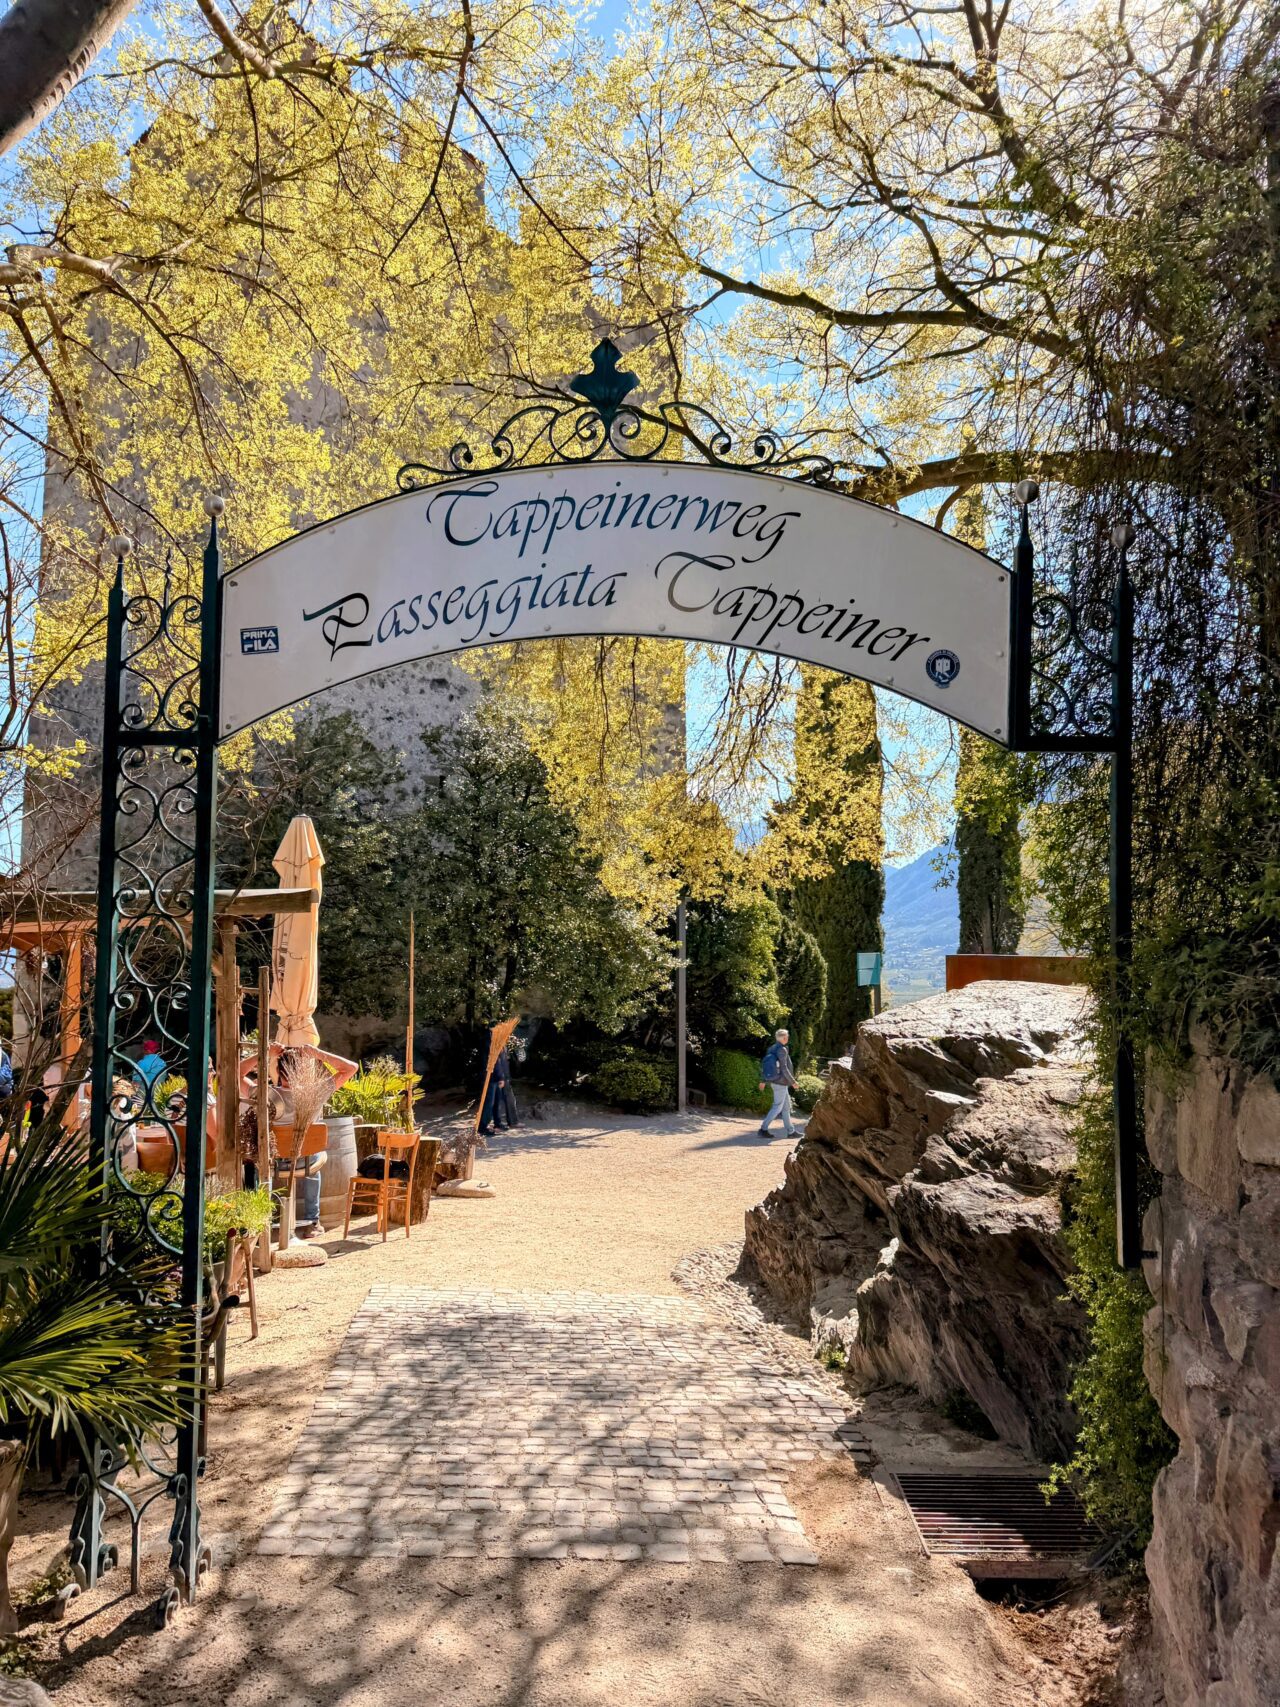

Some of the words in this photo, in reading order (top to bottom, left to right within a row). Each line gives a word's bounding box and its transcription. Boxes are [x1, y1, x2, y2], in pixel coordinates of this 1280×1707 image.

[425, 480, 801, 563] Tappeinerweg
[303, 563, 628, 662] Passeggiata
[655, 551, 931, 662] Tappeiner
[242, 630, 276, 640] PRIMA
[243, 638, 277, 652] FILA
